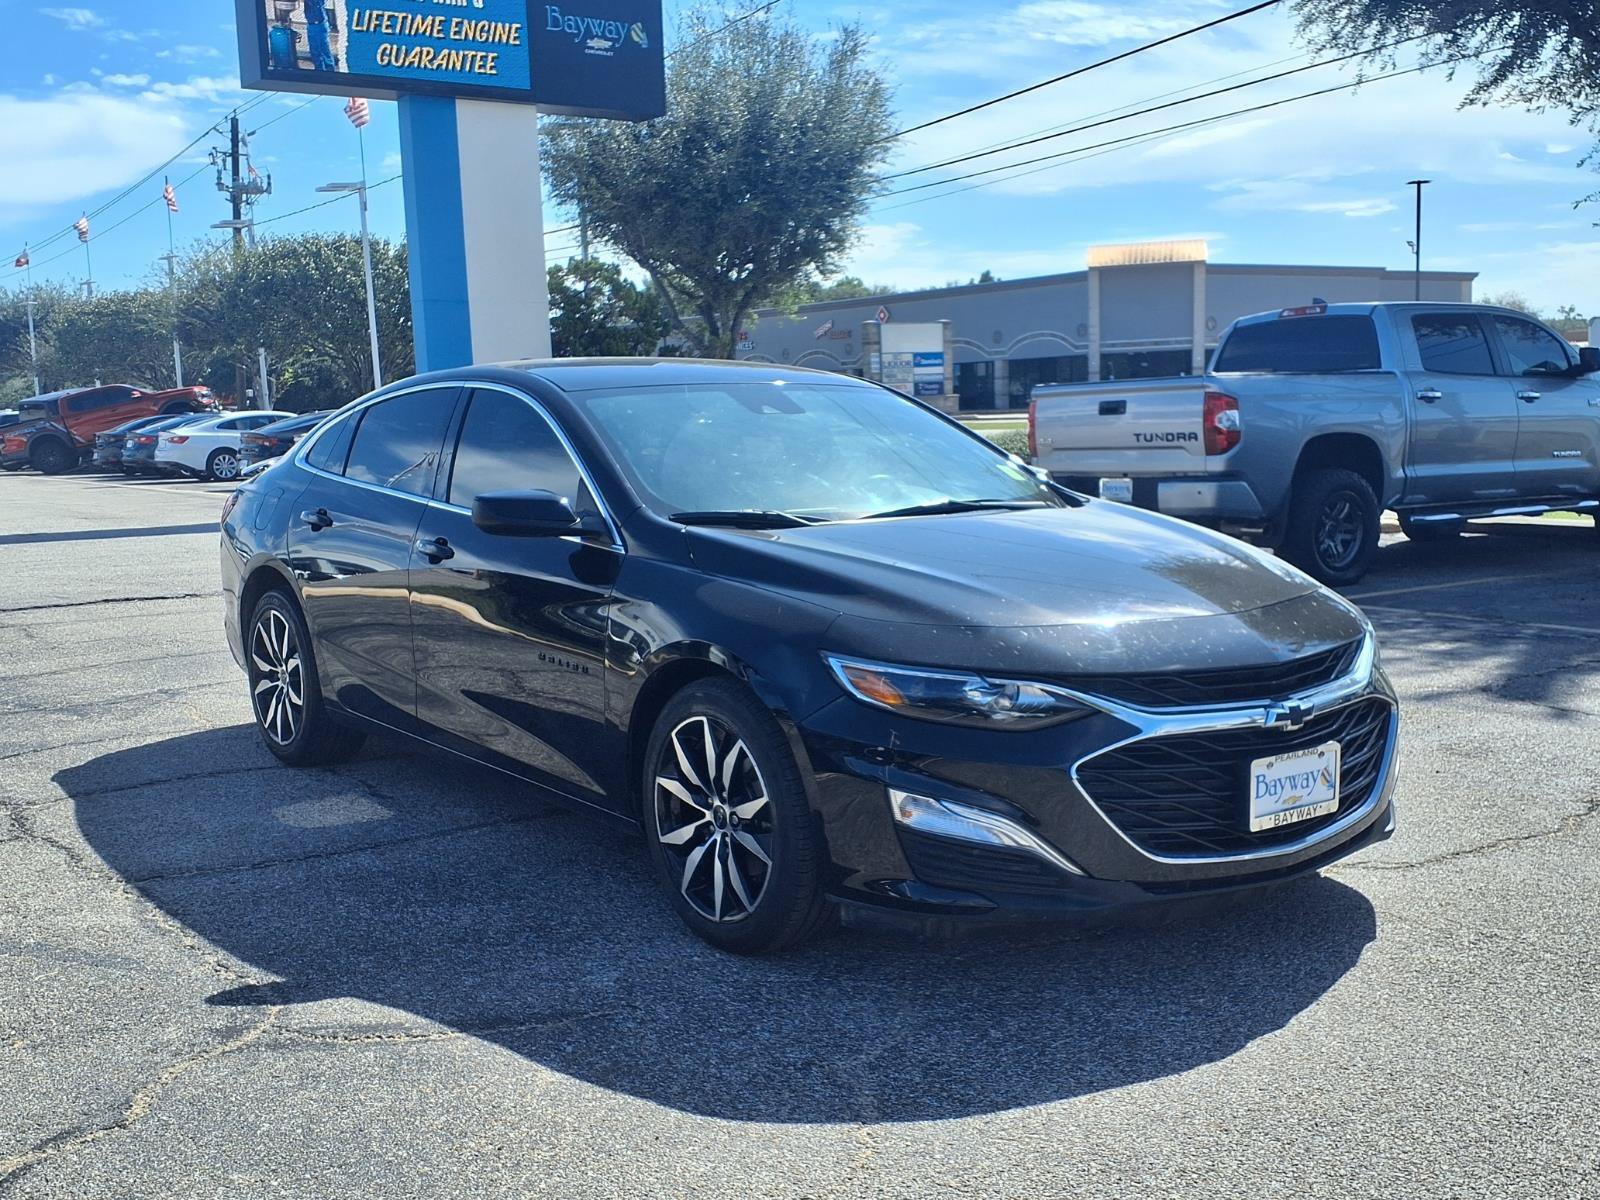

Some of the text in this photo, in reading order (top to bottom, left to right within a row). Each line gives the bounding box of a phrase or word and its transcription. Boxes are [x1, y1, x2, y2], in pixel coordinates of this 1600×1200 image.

[352, 9, 522, 45] LIFETIME ENGINE
[545, 5, 628, 47] Bayway
[376, 43, 498, 74] GUARANTEE
[1133, 431, 1199, 443] TUNDRA
[1274, 748, 1319, 762] PEARLAND
[1255, 768, 1321, 803] Bayway
[1273, 804, 1319, 826] BAYWAY
